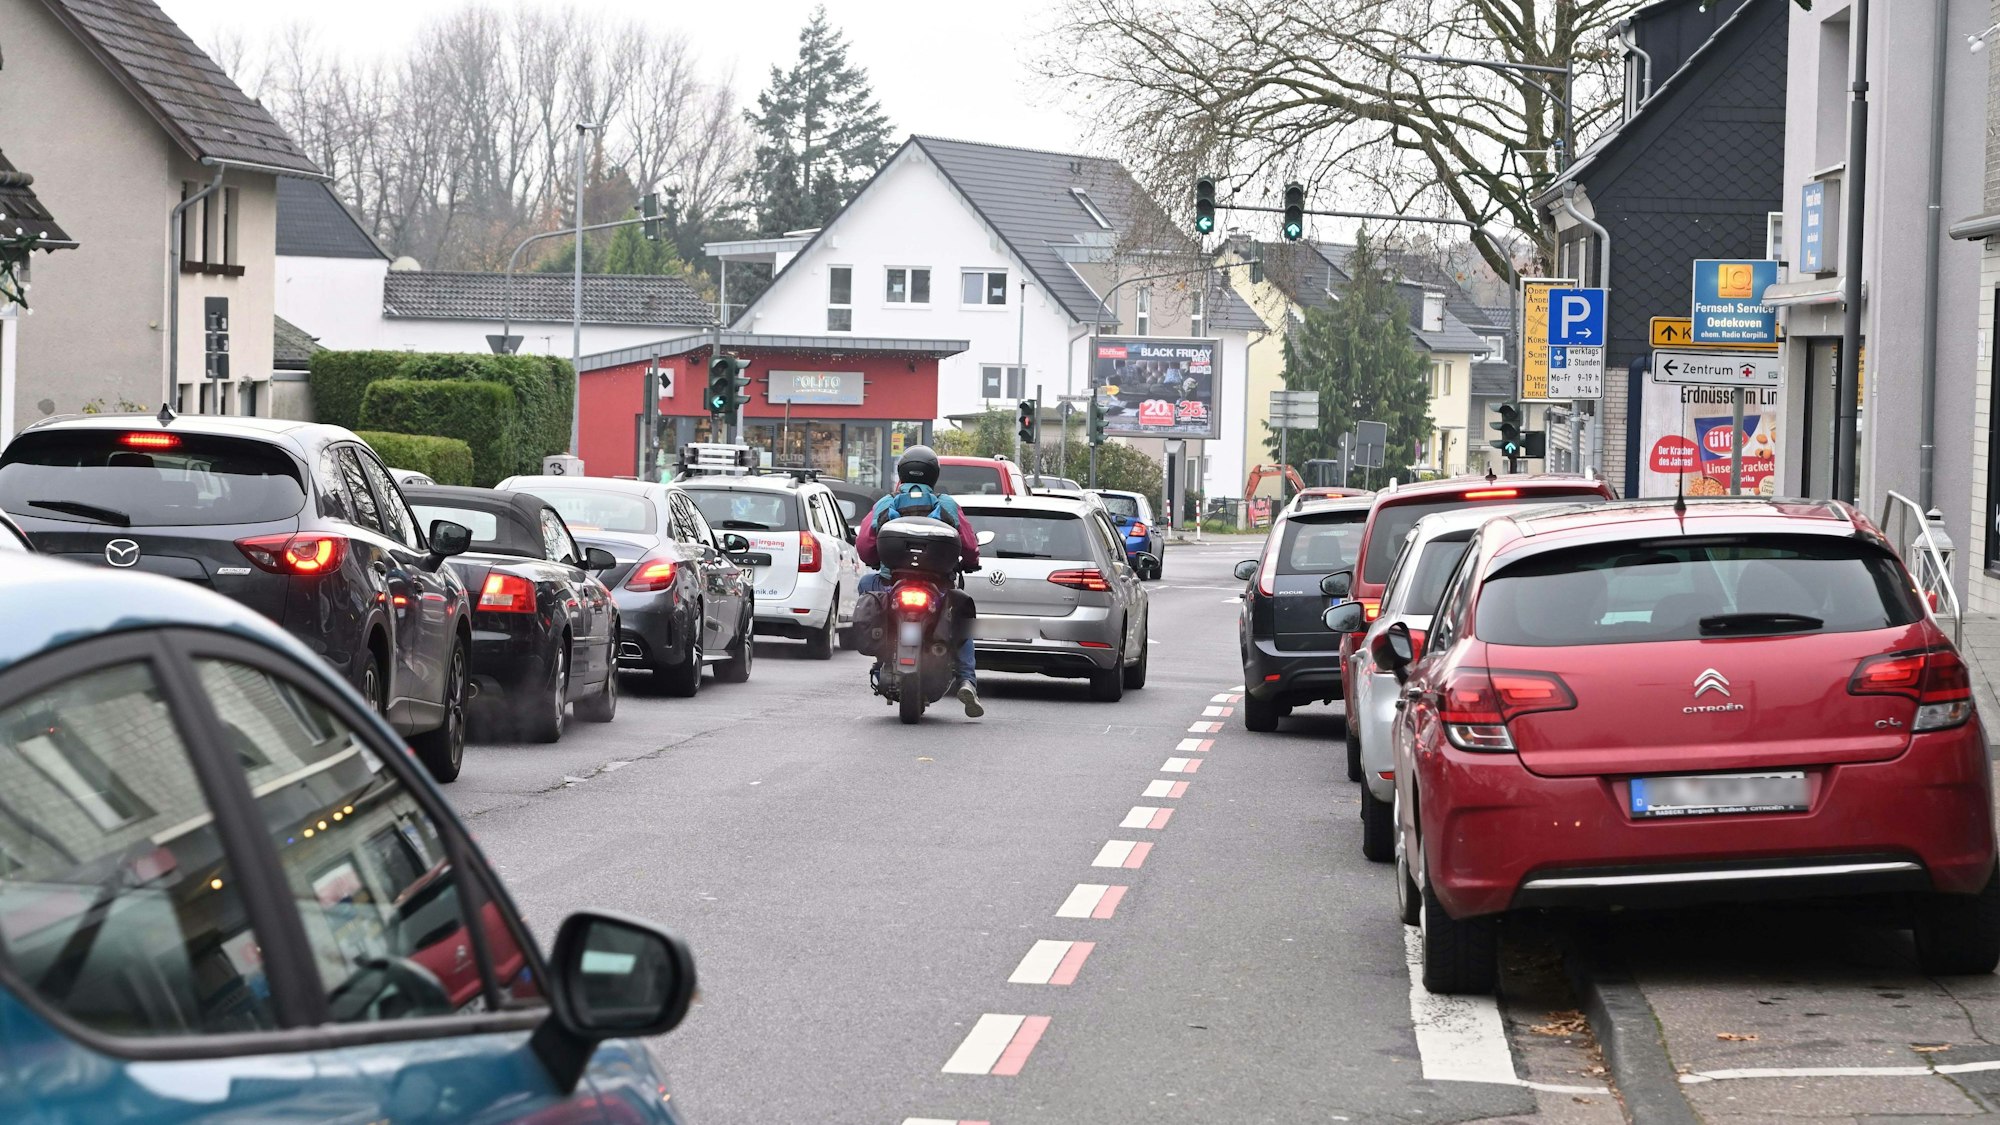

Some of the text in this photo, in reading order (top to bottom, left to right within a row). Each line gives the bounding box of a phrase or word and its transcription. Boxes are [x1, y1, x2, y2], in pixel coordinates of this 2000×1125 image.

[1528, 295, 1548, 303] ÄNDE
[1695, 302, 1775, 313] Fernseh Service
[1561, 296, 1591, 338] P
[1707, 317, 1762, 328] Oedekoven
[1682, 327, 1691, 339] K
[1141, 347, 1212, 359] BLACK FRIDAY
[1570, 348, 1599, 356] werktags
[1574, 358, 1601, 366] Stunden
[1682, 363, 1733, 376] Zentrum
[1551, 374, 1571, 382] Mo-Fr
[1577, 373, 1593, 382] 9-19
[1551, 385, 1559, 394] Sa
[1577, 385, 1592, 394] 9-14
[1659, 446, 1694, 455] Der Kracher
[1659, 457, 1668, 466] des
[1706, 464, 1731, 474] Linse
[758, 539, 785, 547] irrgang
[1683, 702, 1744, 713] CITROËN
[1655, 808, 1684, 816] RADECKI
[1688, 807, 1715, 815] Bergisch
